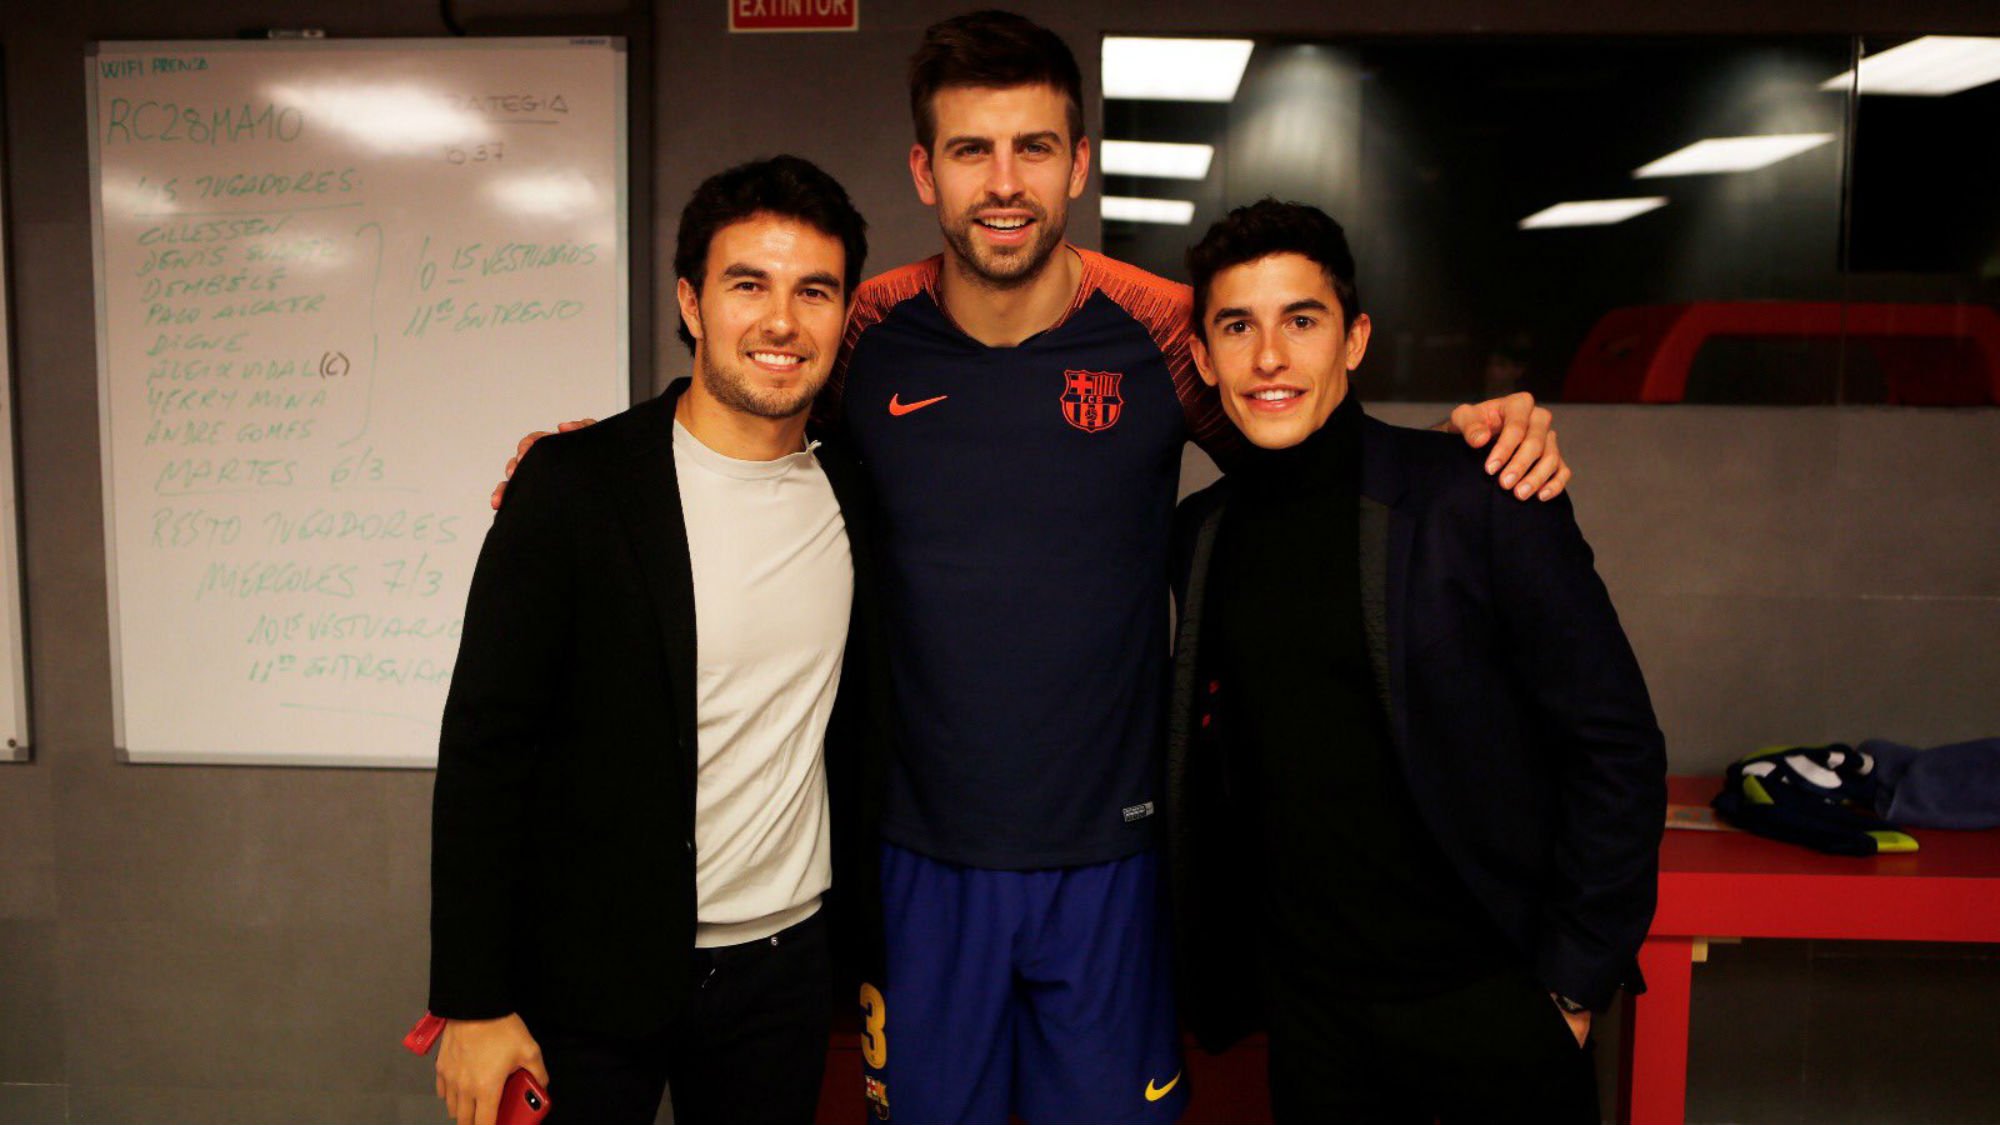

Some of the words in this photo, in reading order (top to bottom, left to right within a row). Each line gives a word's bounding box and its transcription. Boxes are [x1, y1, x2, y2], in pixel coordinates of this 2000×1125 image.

[738, 0, 848, 16] EXTINTOR
[100, 60, 145, 79] WIFI
[153, 458, 299, 492] MARTES
[330, 446, 386, 489] 6/3
[150, 506, 243, 549] RESTO
[381, 551, 444, 598] 7/3
[860, 982, 887, 1069] 3
